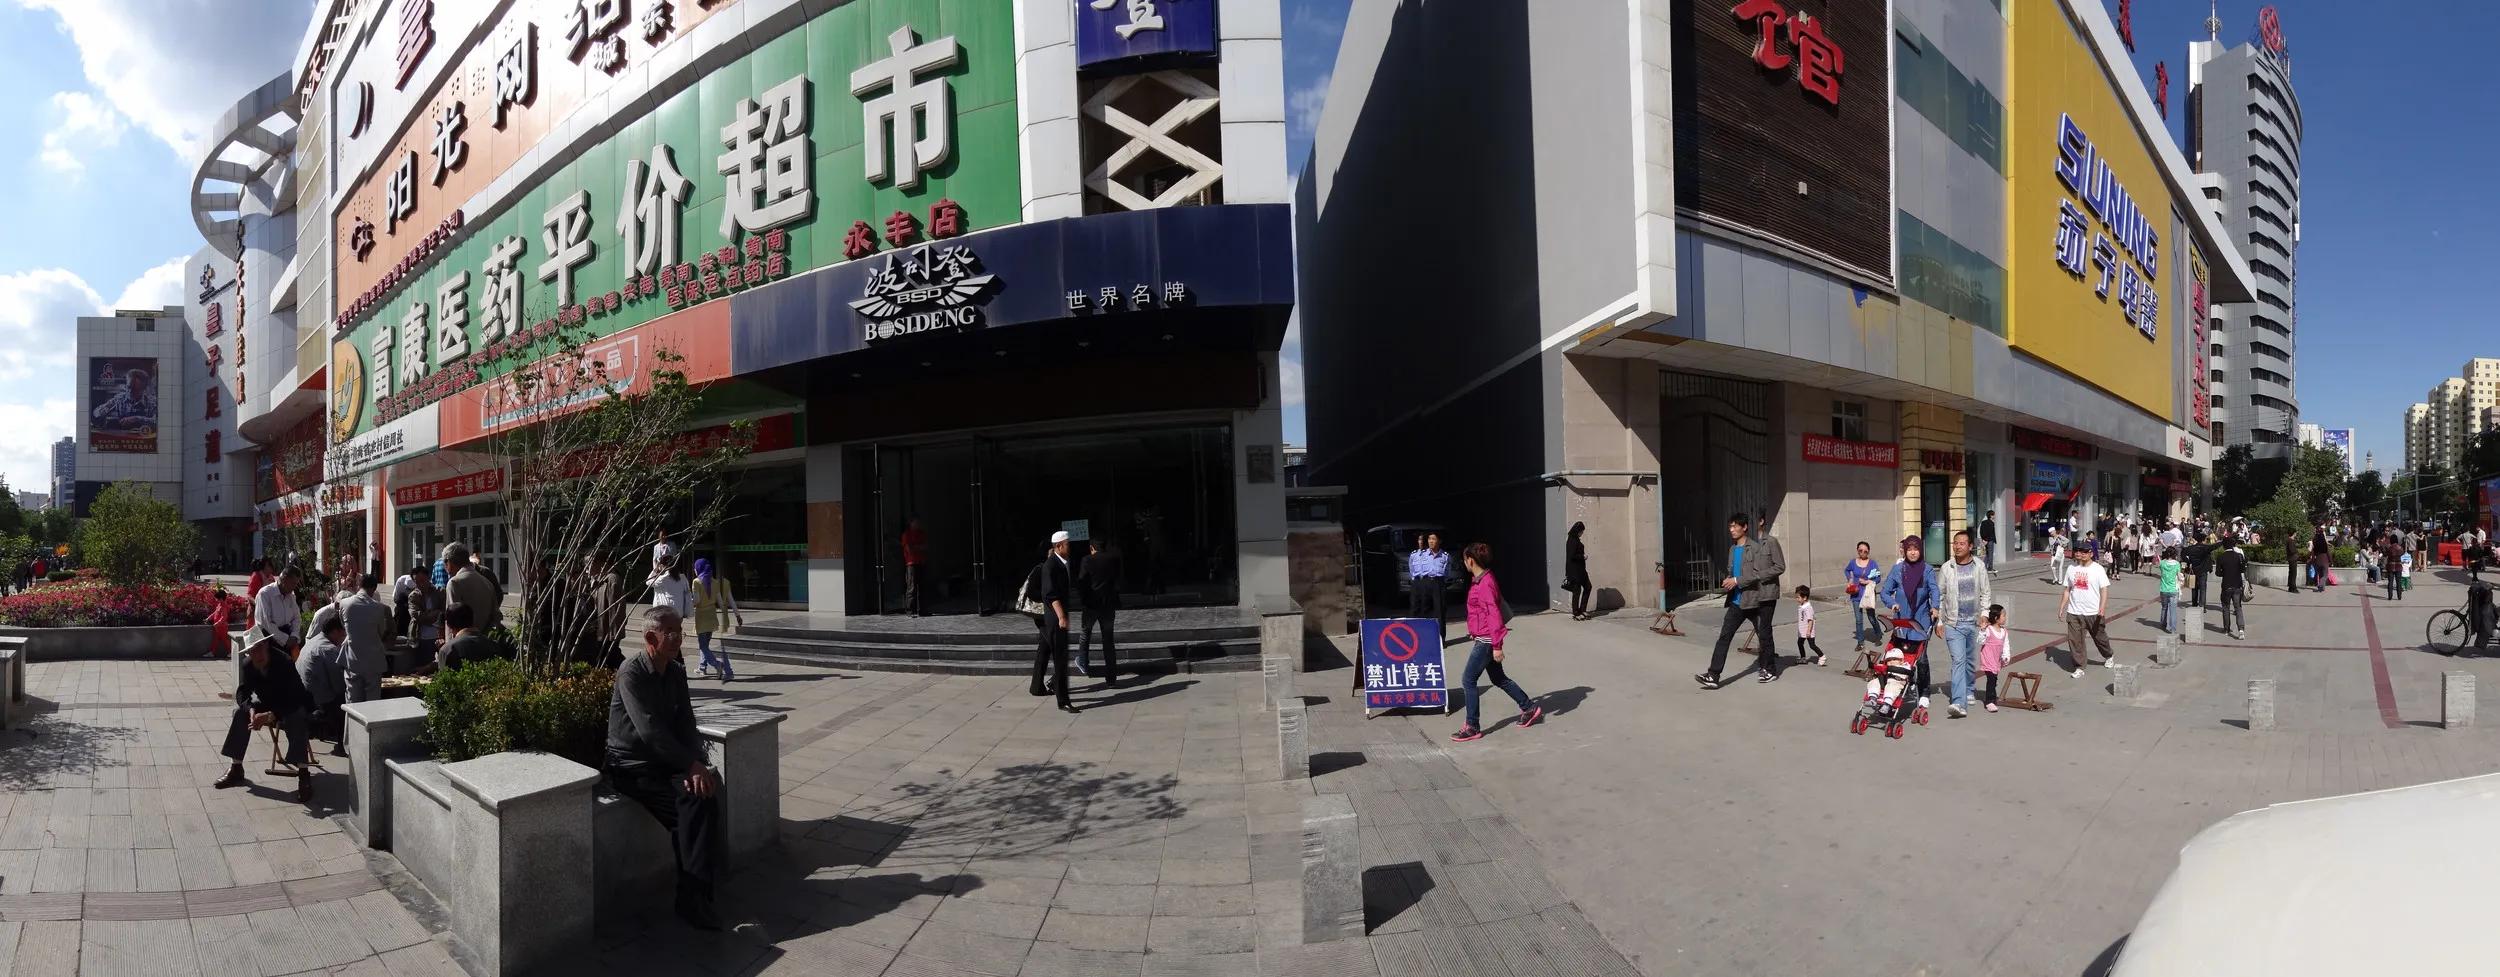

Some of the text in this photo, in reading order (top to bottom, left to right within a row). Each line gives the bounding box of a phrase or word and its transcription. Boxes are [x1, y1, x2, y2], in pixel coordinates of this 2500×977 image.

[1732, 0, 1845, 105] 馆
[371, 24, 961, 405] 富康医药平价超市
[2055, 111, 2159, 281] SUNING
[844, 197, 960, 259] 永丰店
[666, 252, 786, 308] 医保定点药店
[863, 244, 976, 298] 波司登
[1065, 281, 1186, 310] 世界名牌
[2055, 197, 2159, 343] 苏宁电器
[863, 305, 977, 342] BOSIDENG
[205, 302, 222, 464] 皇子足道
[1366, 662, 1443, 688] 禁止停车
[1371, 691, 1442, 705] 城东交警大队
